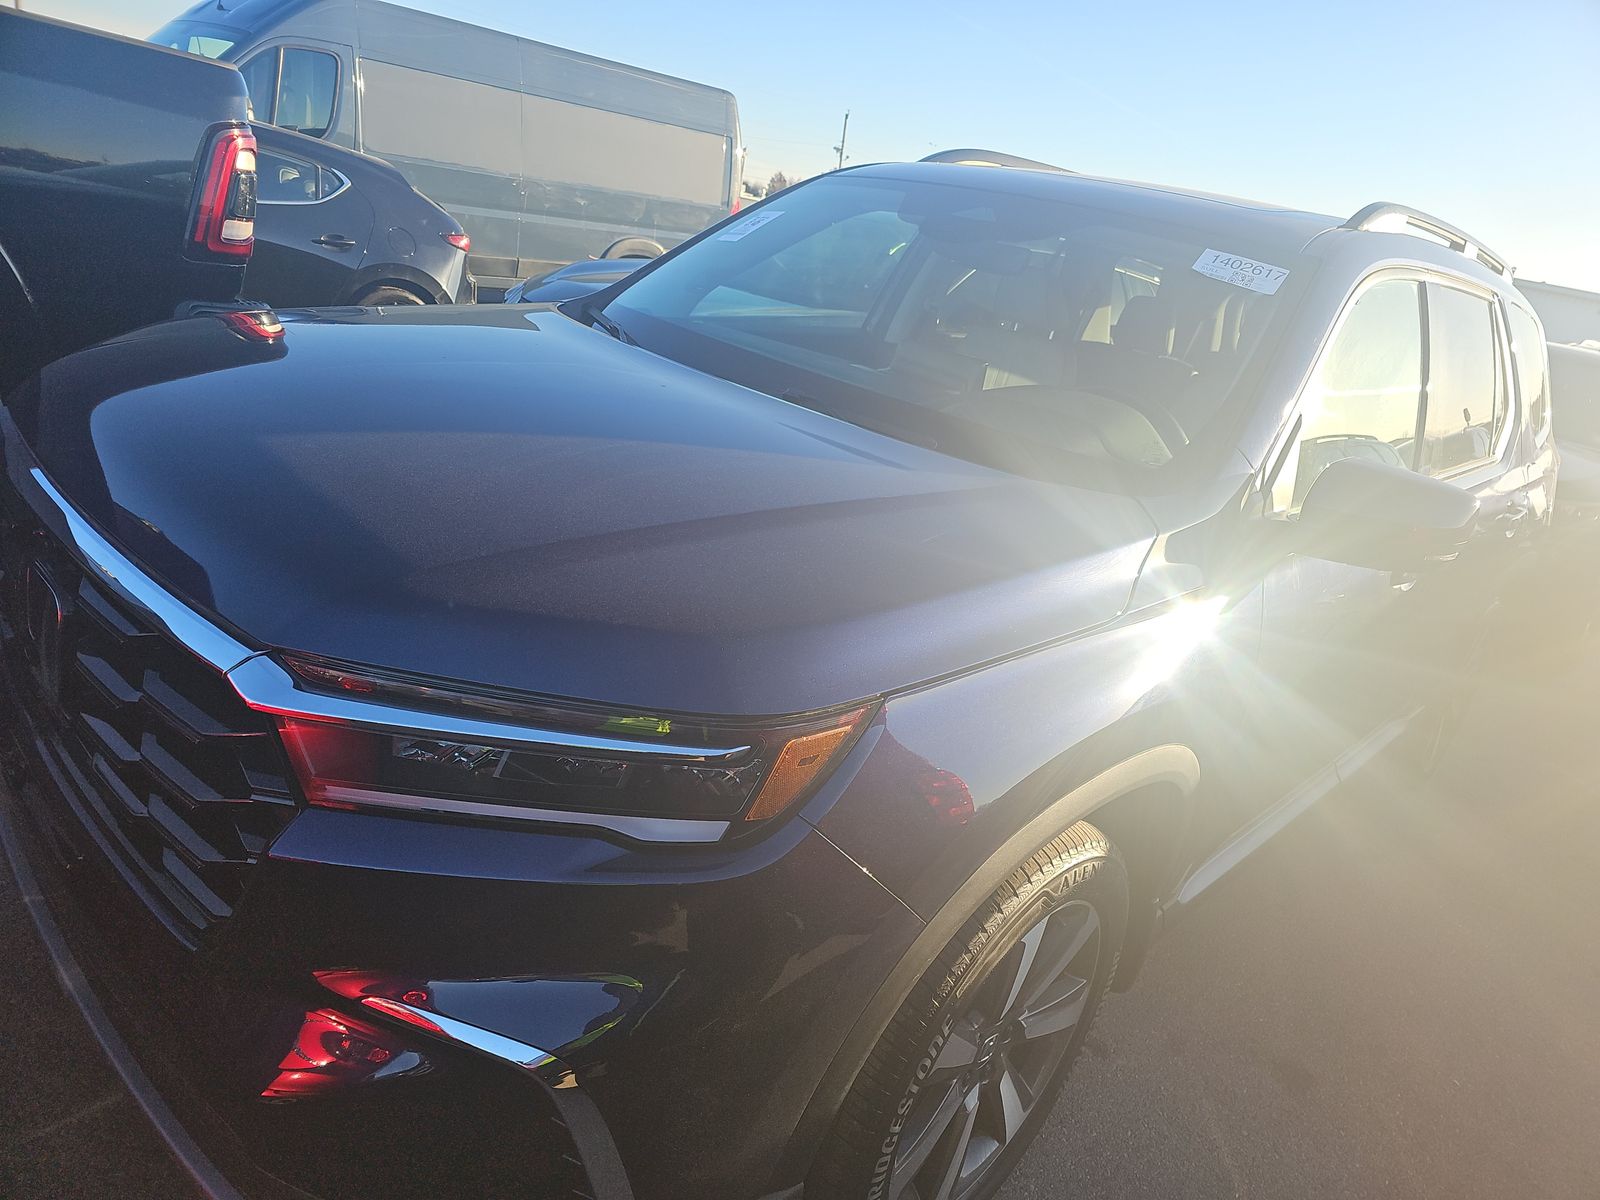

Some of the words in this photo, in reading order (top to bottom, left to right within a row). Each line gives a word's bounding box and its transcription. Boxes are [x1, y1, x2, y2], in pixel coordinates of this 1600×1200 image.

[1211, 254, 1287, 281] 1402617
[1058, 862, 1102, 896] ALEN
[867, 1013, 954, 1200] RIDGESTONE
